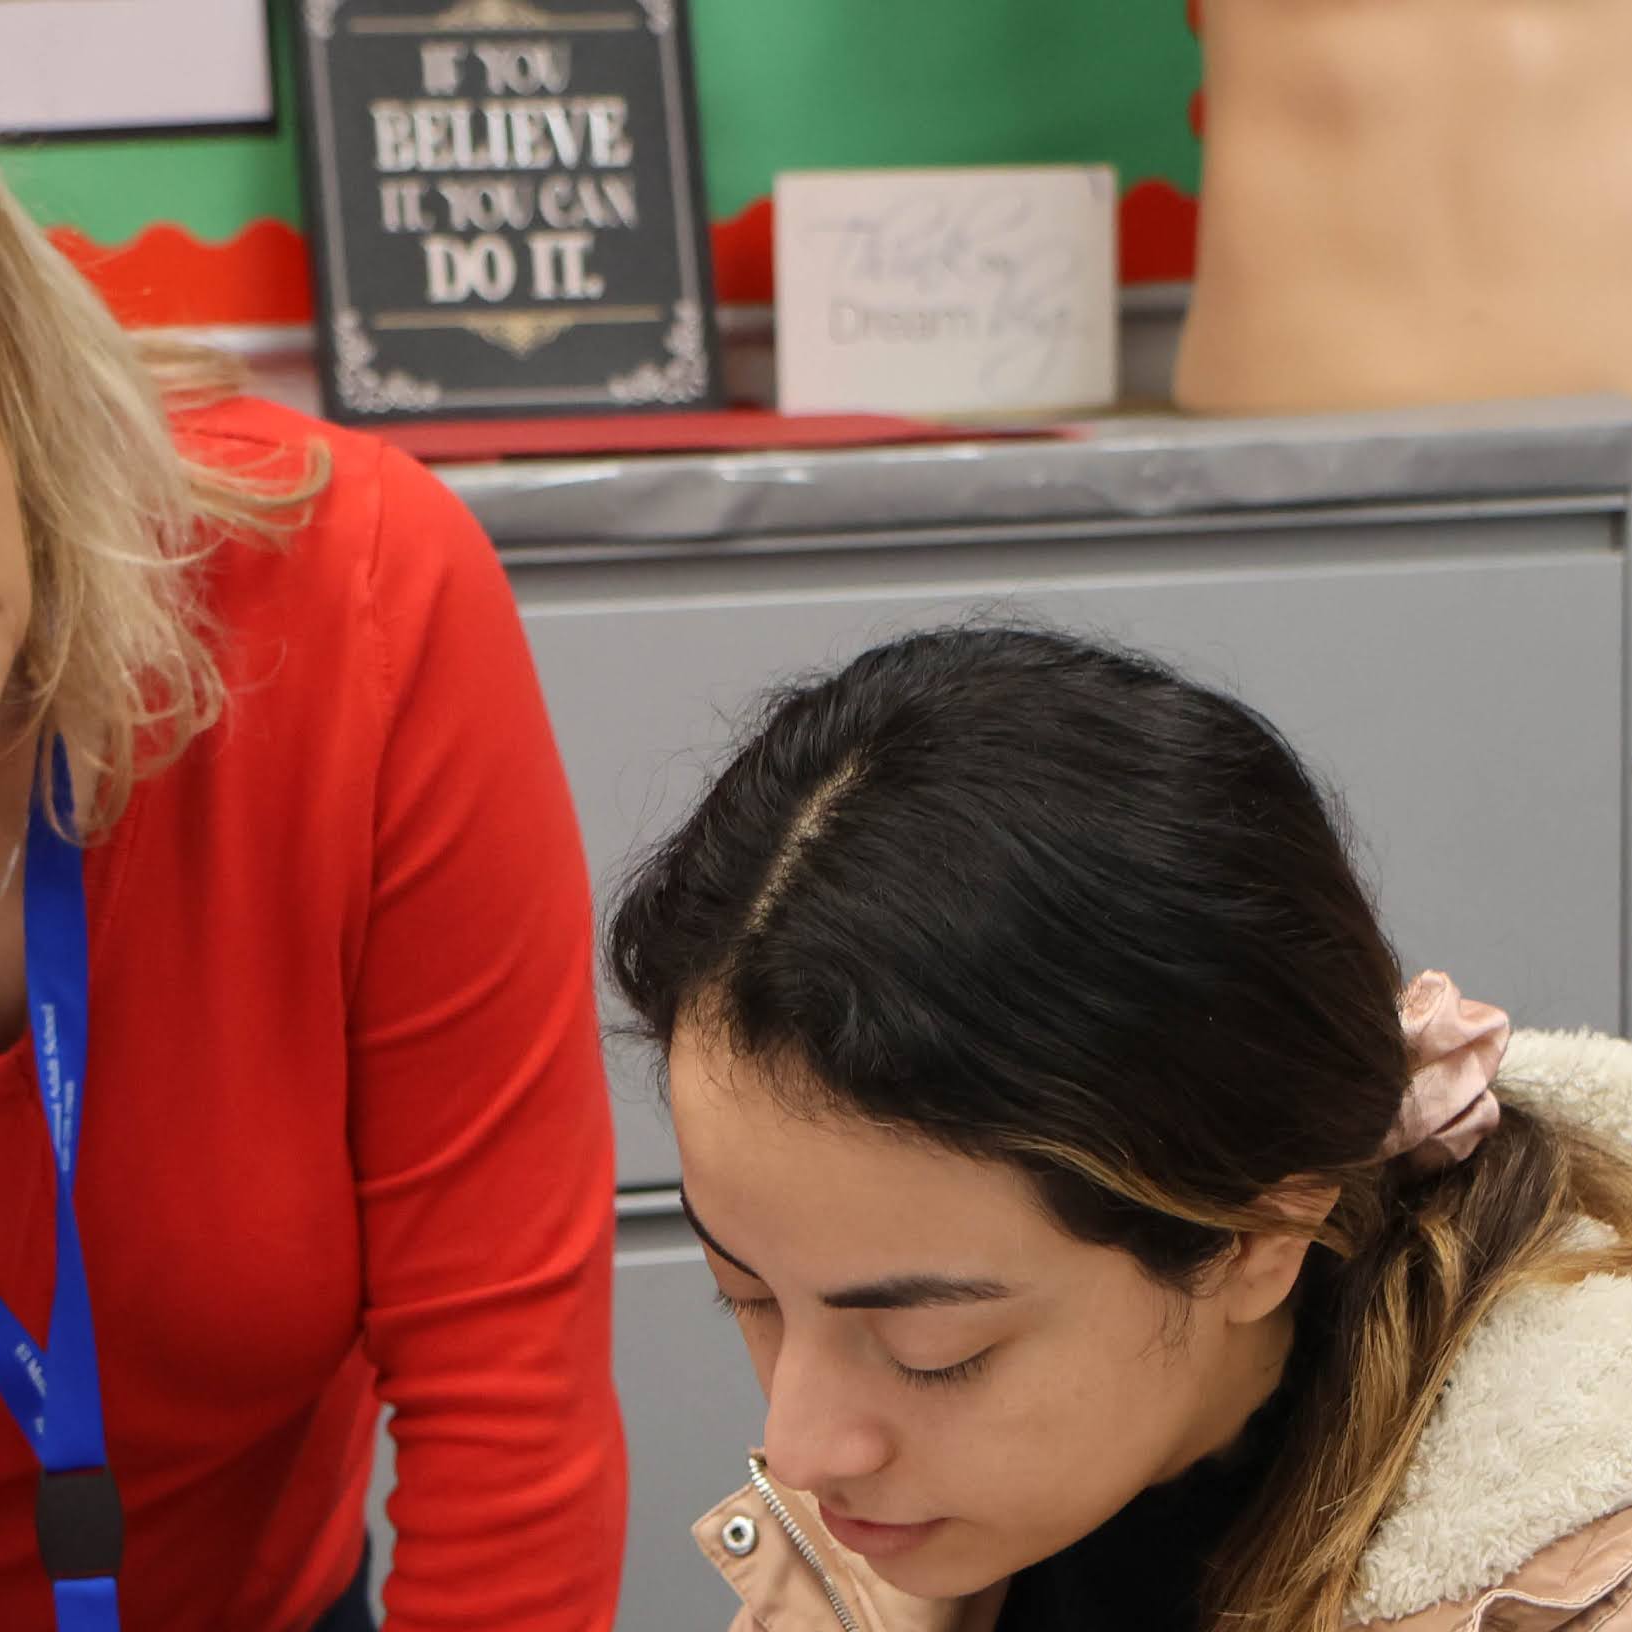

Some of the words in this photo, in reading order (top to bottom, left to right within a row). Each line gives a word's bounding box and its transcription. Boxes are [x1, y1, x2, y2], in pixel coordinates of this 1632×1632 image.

[473, 42, 571, 96] YOU
[369, 97, 633, 172] BELIEVE
[437, 175, 535, 231] YOU
[538, 174, 637, 230] CAN
[423, 232, 517, 303] DO
